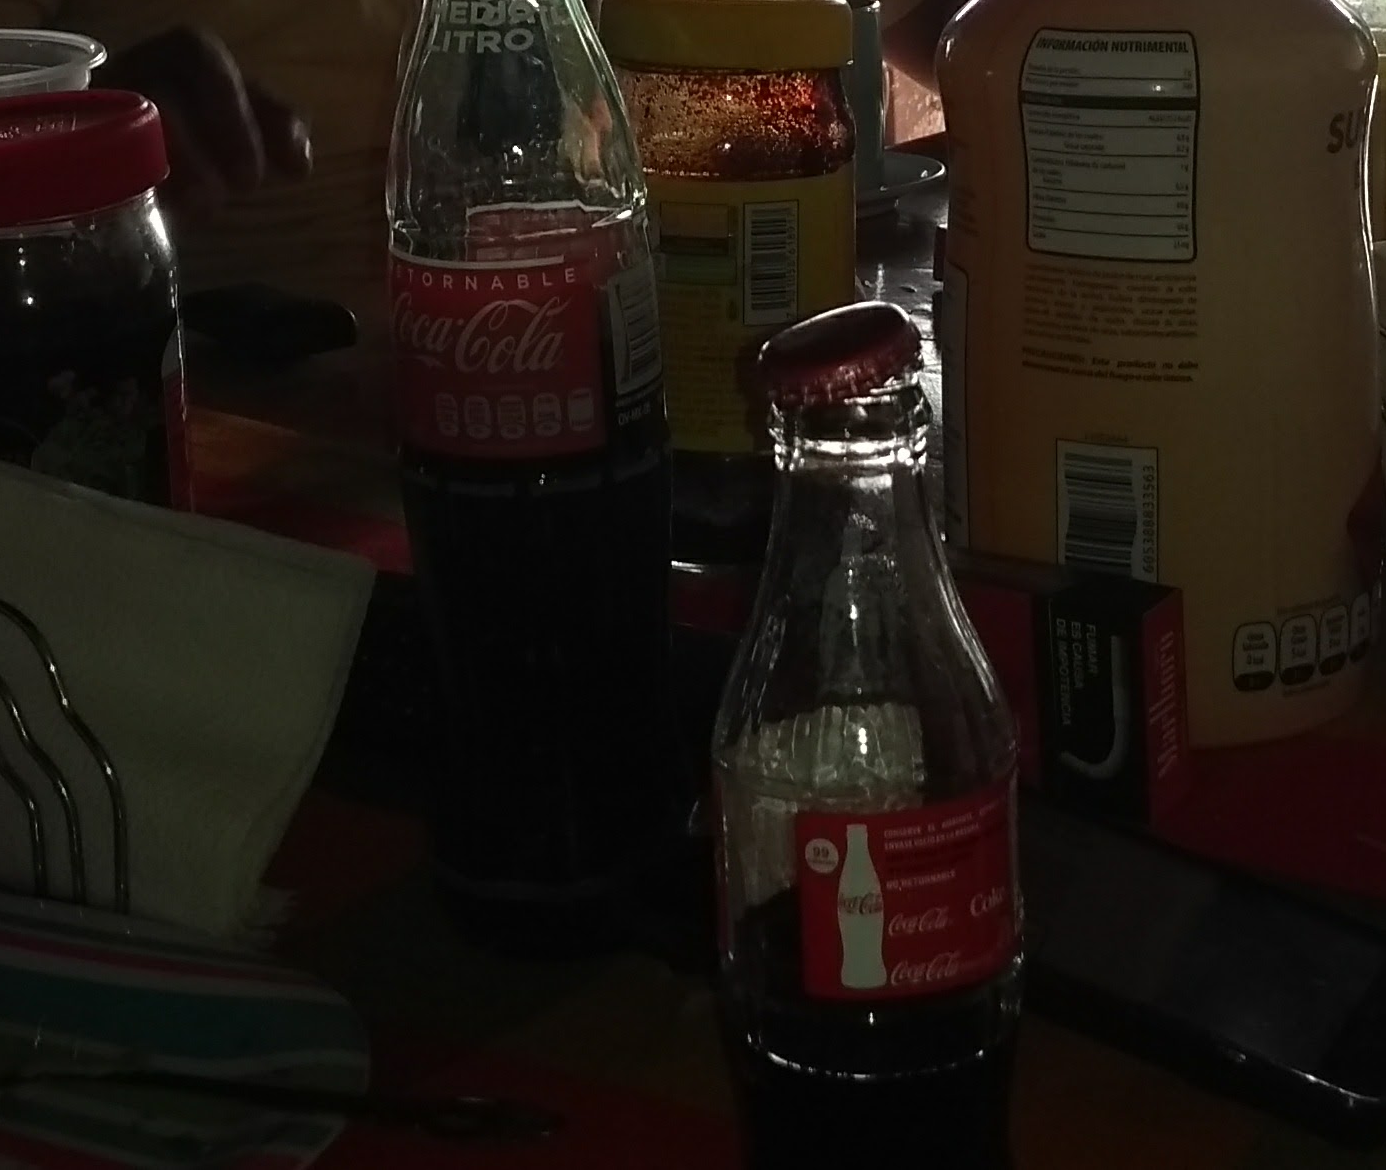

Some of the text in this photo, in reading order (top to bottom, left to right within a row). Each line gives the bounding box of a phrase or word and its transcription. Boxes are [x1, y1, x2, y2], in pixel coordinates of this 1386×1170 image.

[427, 28, 534, 54] LITRO
[1036, 36, 1190, 54] INFORMACIÓN NUTRIMENTAL
[1056, 617, 1072, 727] DE IMPOTENCIA
[1070, 621, 1084, 689] ES CAUSA
[1085, 623, 1100, 676] FUMAR
